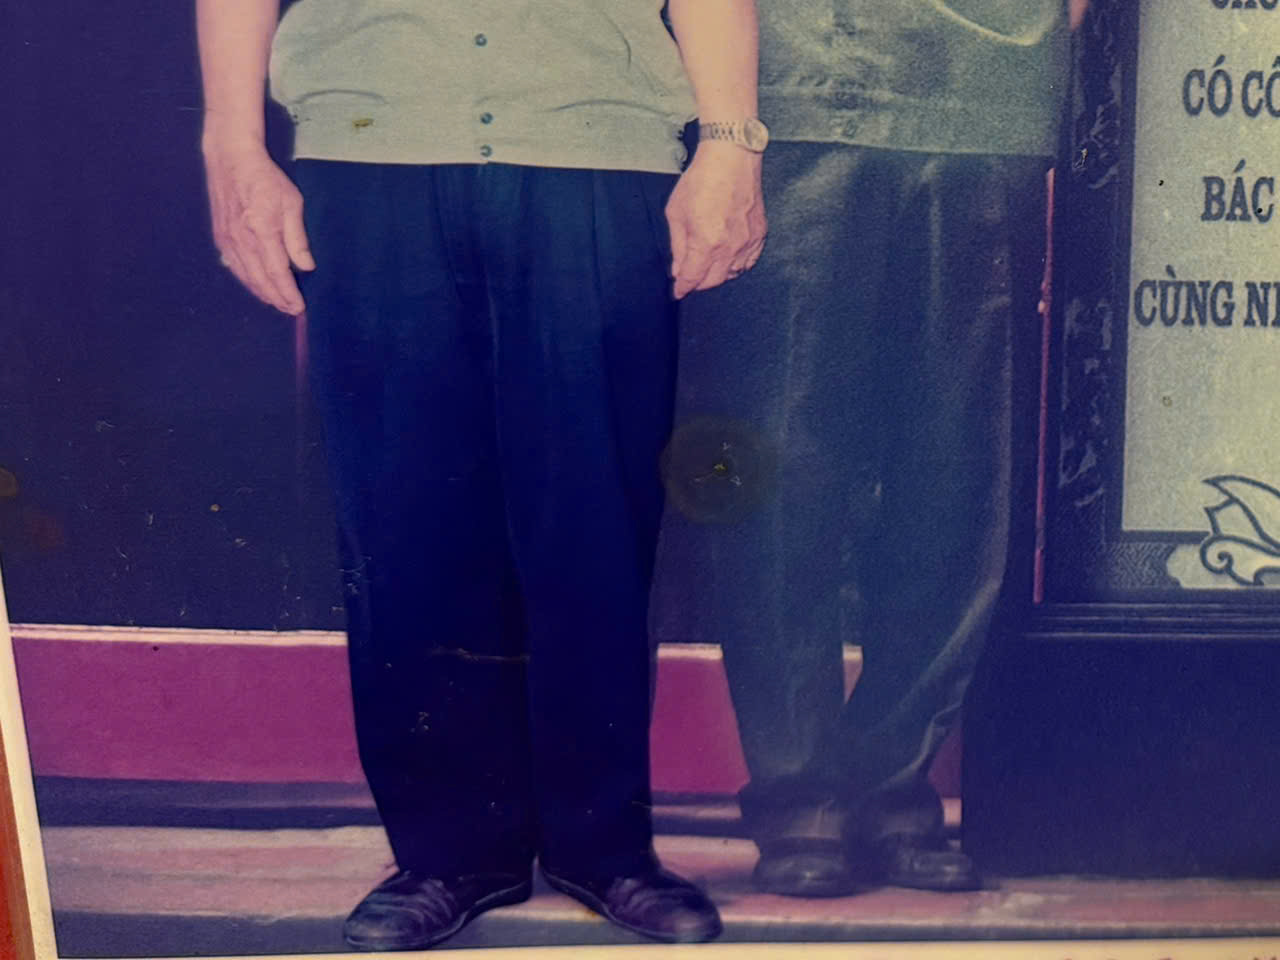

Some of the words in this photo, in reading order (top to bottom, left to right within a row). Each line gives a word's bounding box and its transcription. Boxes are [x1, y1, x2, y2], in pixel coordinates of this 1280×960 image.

[1182, 54, 1234, 117] CÓ
[1200, 158, 1276, 223] BÁC
[1133, 265, 1236, 328] CÙNG
